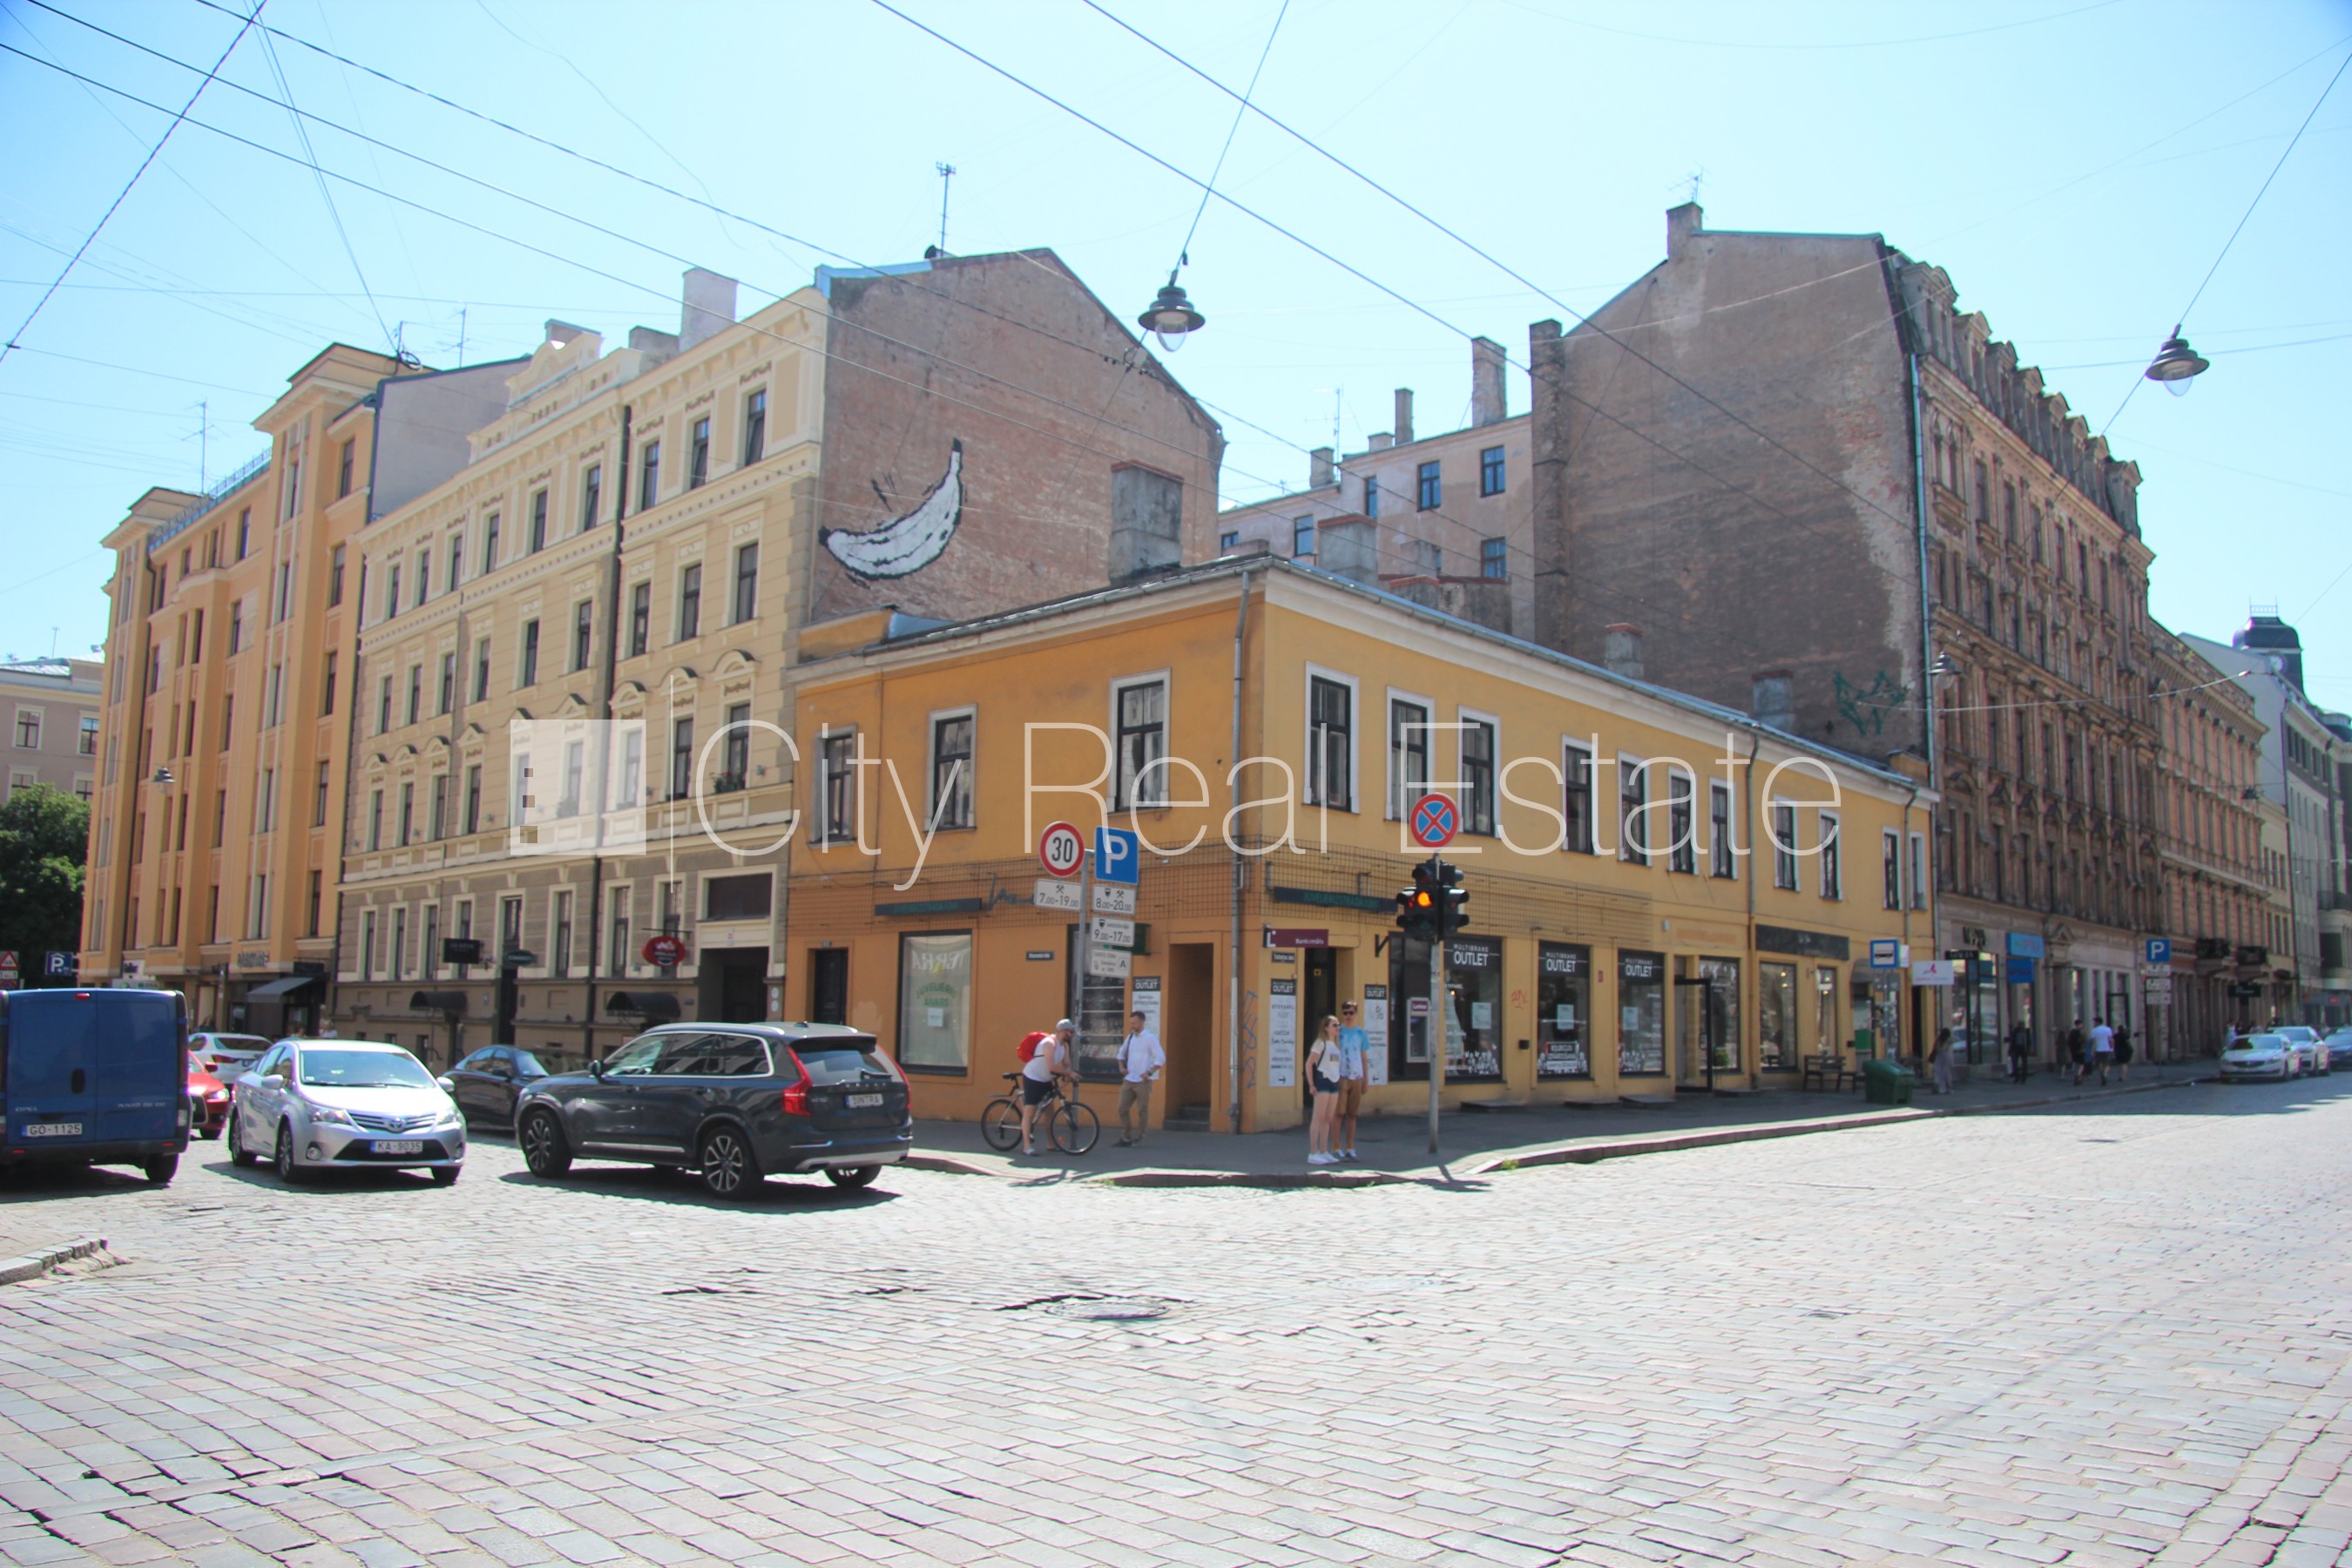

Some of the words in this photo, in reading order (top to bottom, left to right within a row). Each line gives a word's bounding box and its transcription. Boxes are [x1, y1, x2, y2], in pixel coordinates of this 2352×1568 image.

[1051, 836, 1073, 863] 30
[1105, 834, 1129, 875] P
[1039, 893, 1079, 907] 7.00-19.00
[1096, 897, 1132, 911] 8.00-20.00
[1094, 929, 1132, 943] 9.00-17.00
[2151, 942, 2166, 960] P
[1119, 960, 1126, 969] A
[1453, 950, 1489, 967] OUTLET
[1545, 958, 1577, 973] OUTLET
[1625, 965, 1652, 977] OUTLET
[1273, 985, 1294, 994] OUTLET
[30, 1125, 81, 1135] GO-1125
[377, 1142, 422, 1151] KA-9035
